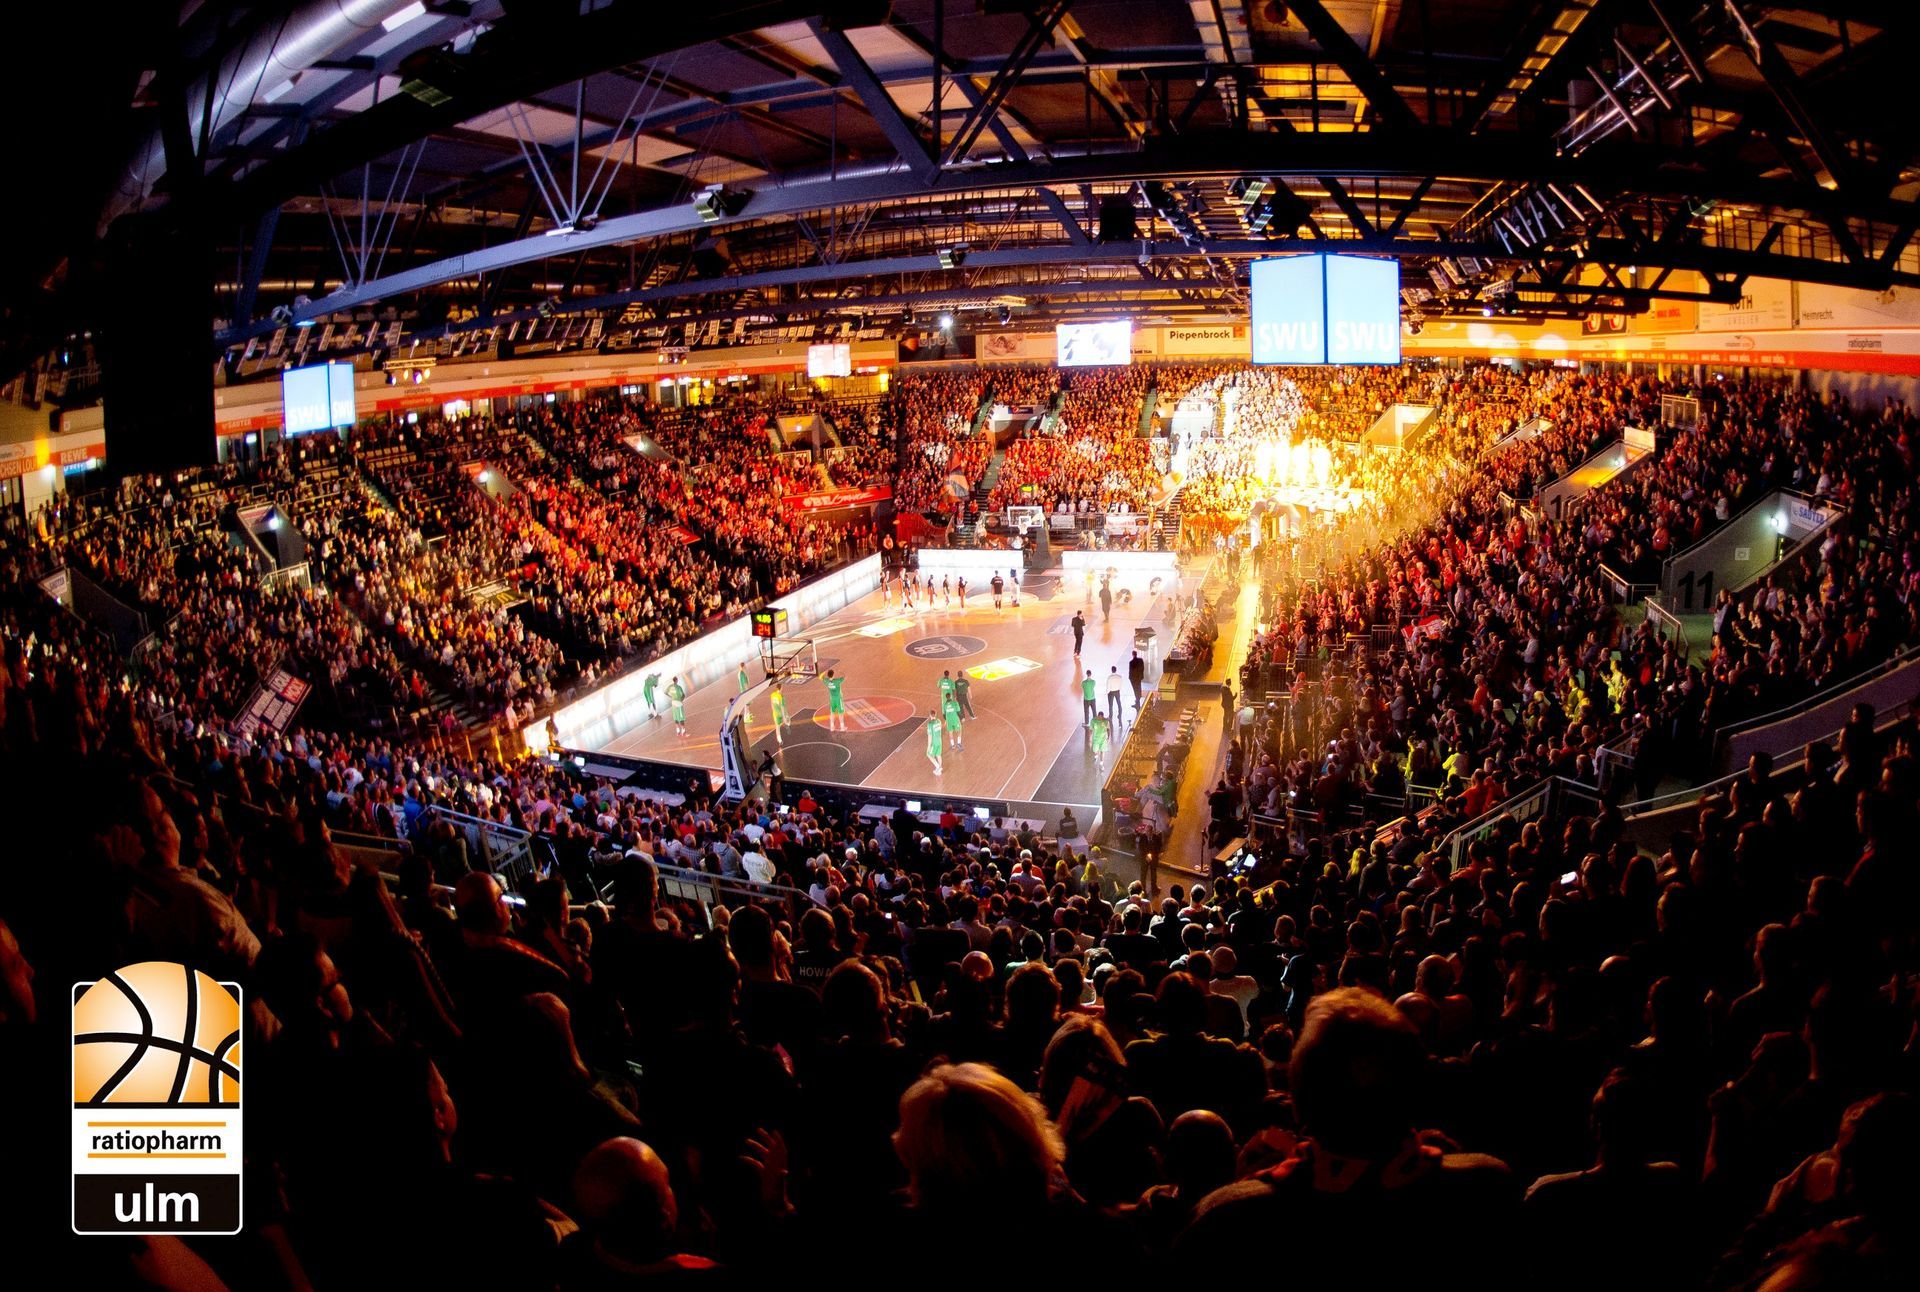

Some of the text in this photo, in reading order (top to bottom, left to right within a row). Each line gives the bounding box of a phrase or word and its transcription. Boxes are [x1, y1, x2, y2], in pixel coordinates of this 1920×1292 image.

[1169, 330, 1231, 341] Piepenbrock
[1258, 322, 1319, 351] SWU
[1334, 321, 1396, 351] SWU
[1848, 338, 1882, 350] ratiopharm
[289, 404, 326, 428] SWU
[333, 400, 354, 419] SWU
[61, 447, 88, 463] REWE
[1678, 571, 1714, 610] 11
[758, 623, 771, 636] 24
